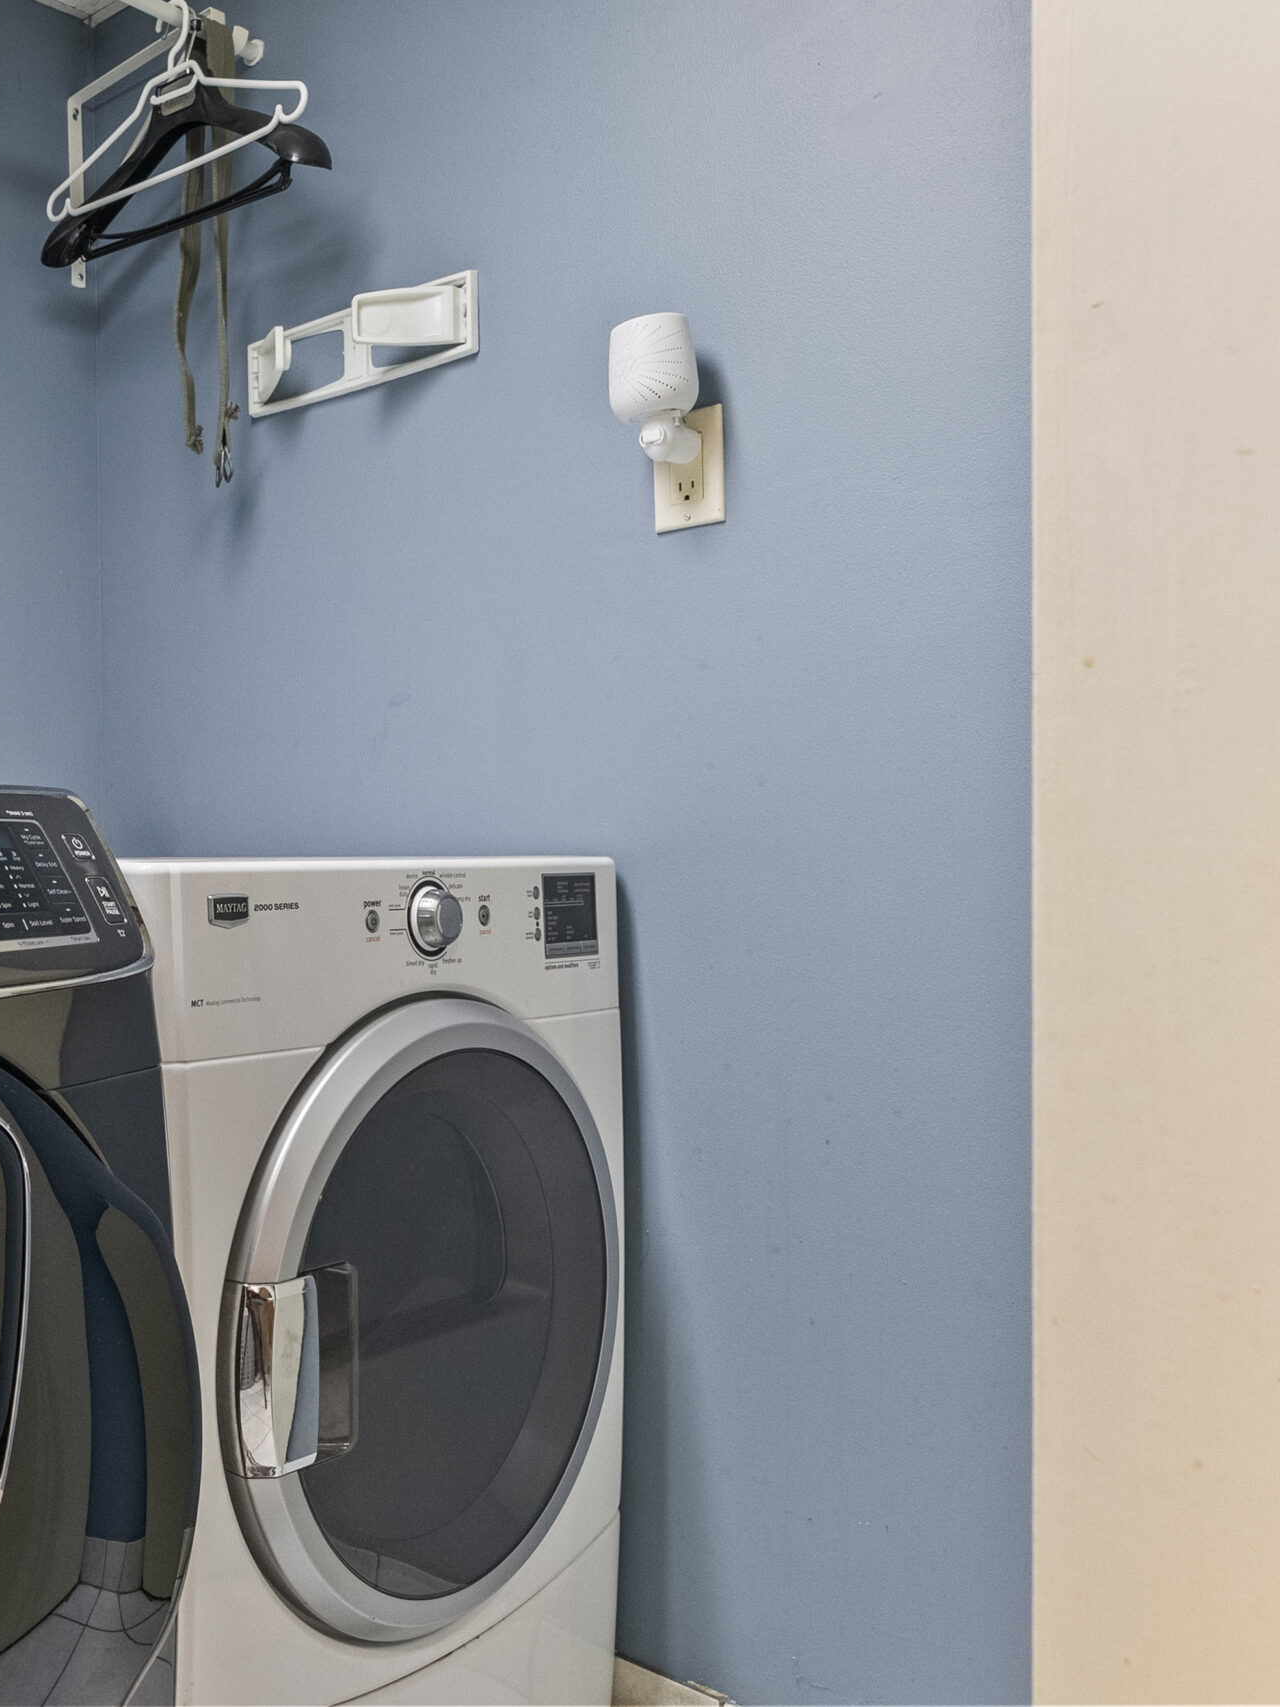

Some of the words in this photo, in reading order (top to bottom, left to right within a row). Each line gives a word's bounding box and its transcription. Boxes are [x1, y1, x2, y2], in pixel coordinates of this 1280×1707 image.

[478, 894, 490, 902] start
[216, 902, 247, 913] MAYTAG
[253, 903, 273, 911] 2000
[274, 902, 299, 910] SERIES
[363, 900, 382, 908] power
[191, 999, 204, 1008] MCT
